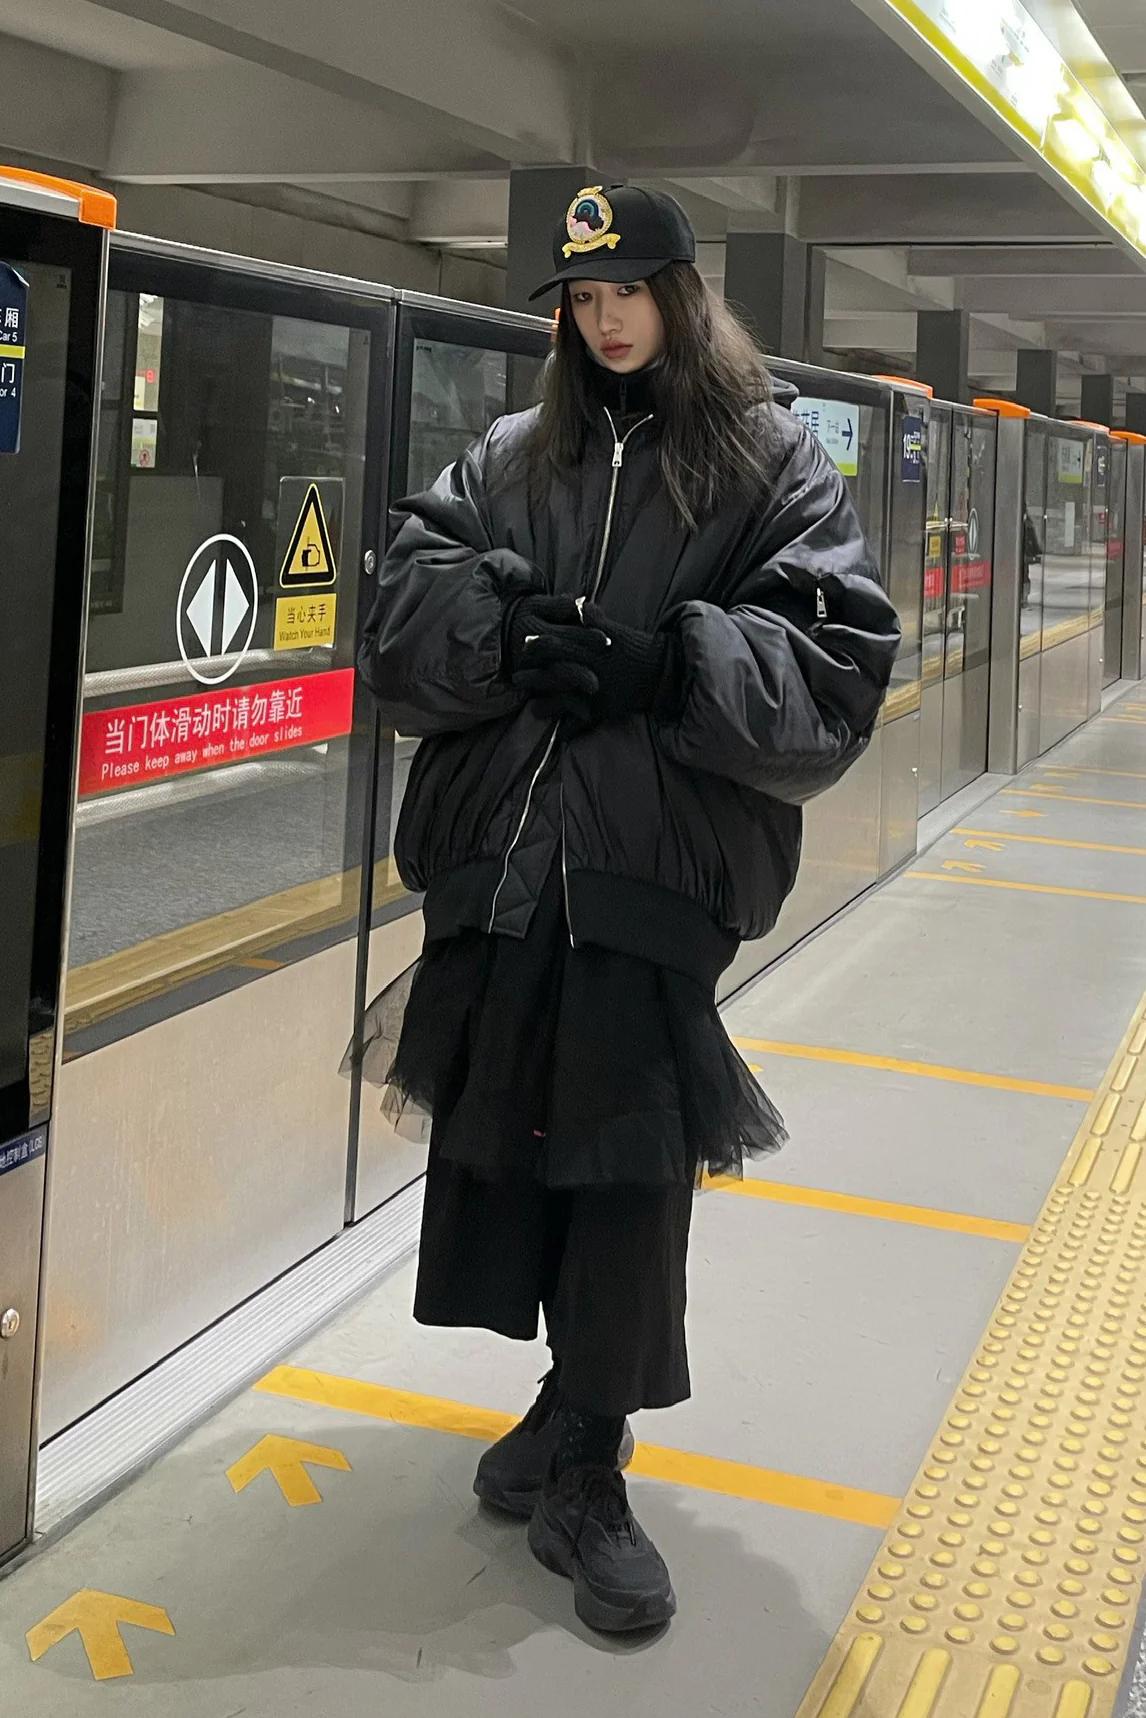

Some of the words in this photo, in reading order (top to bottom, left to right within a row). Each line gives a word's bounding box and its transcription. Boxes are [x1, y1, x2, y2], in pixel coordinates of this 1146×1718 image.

[12, 332, 18, 343] 5
[10, 387, 16, 398] 4
[287, 603, 327, 624] 当心夹手
[279, 631, 299, 641] Watch
[300, 629, 314, 639] Your
[315, 626, 331, 637] Hand
[105, 686, 303, 754] 当门体滑动时请勿靠近
[101, 762, 140, 780] Please
[145, 755, 170, 771] keep
[174, 748, 198, 764] away
[202, 742, 225, 758] when
[229, 737, 245, 752] the
[249, 732, 269, 748] door
[274, 724, 303, 742] slides
